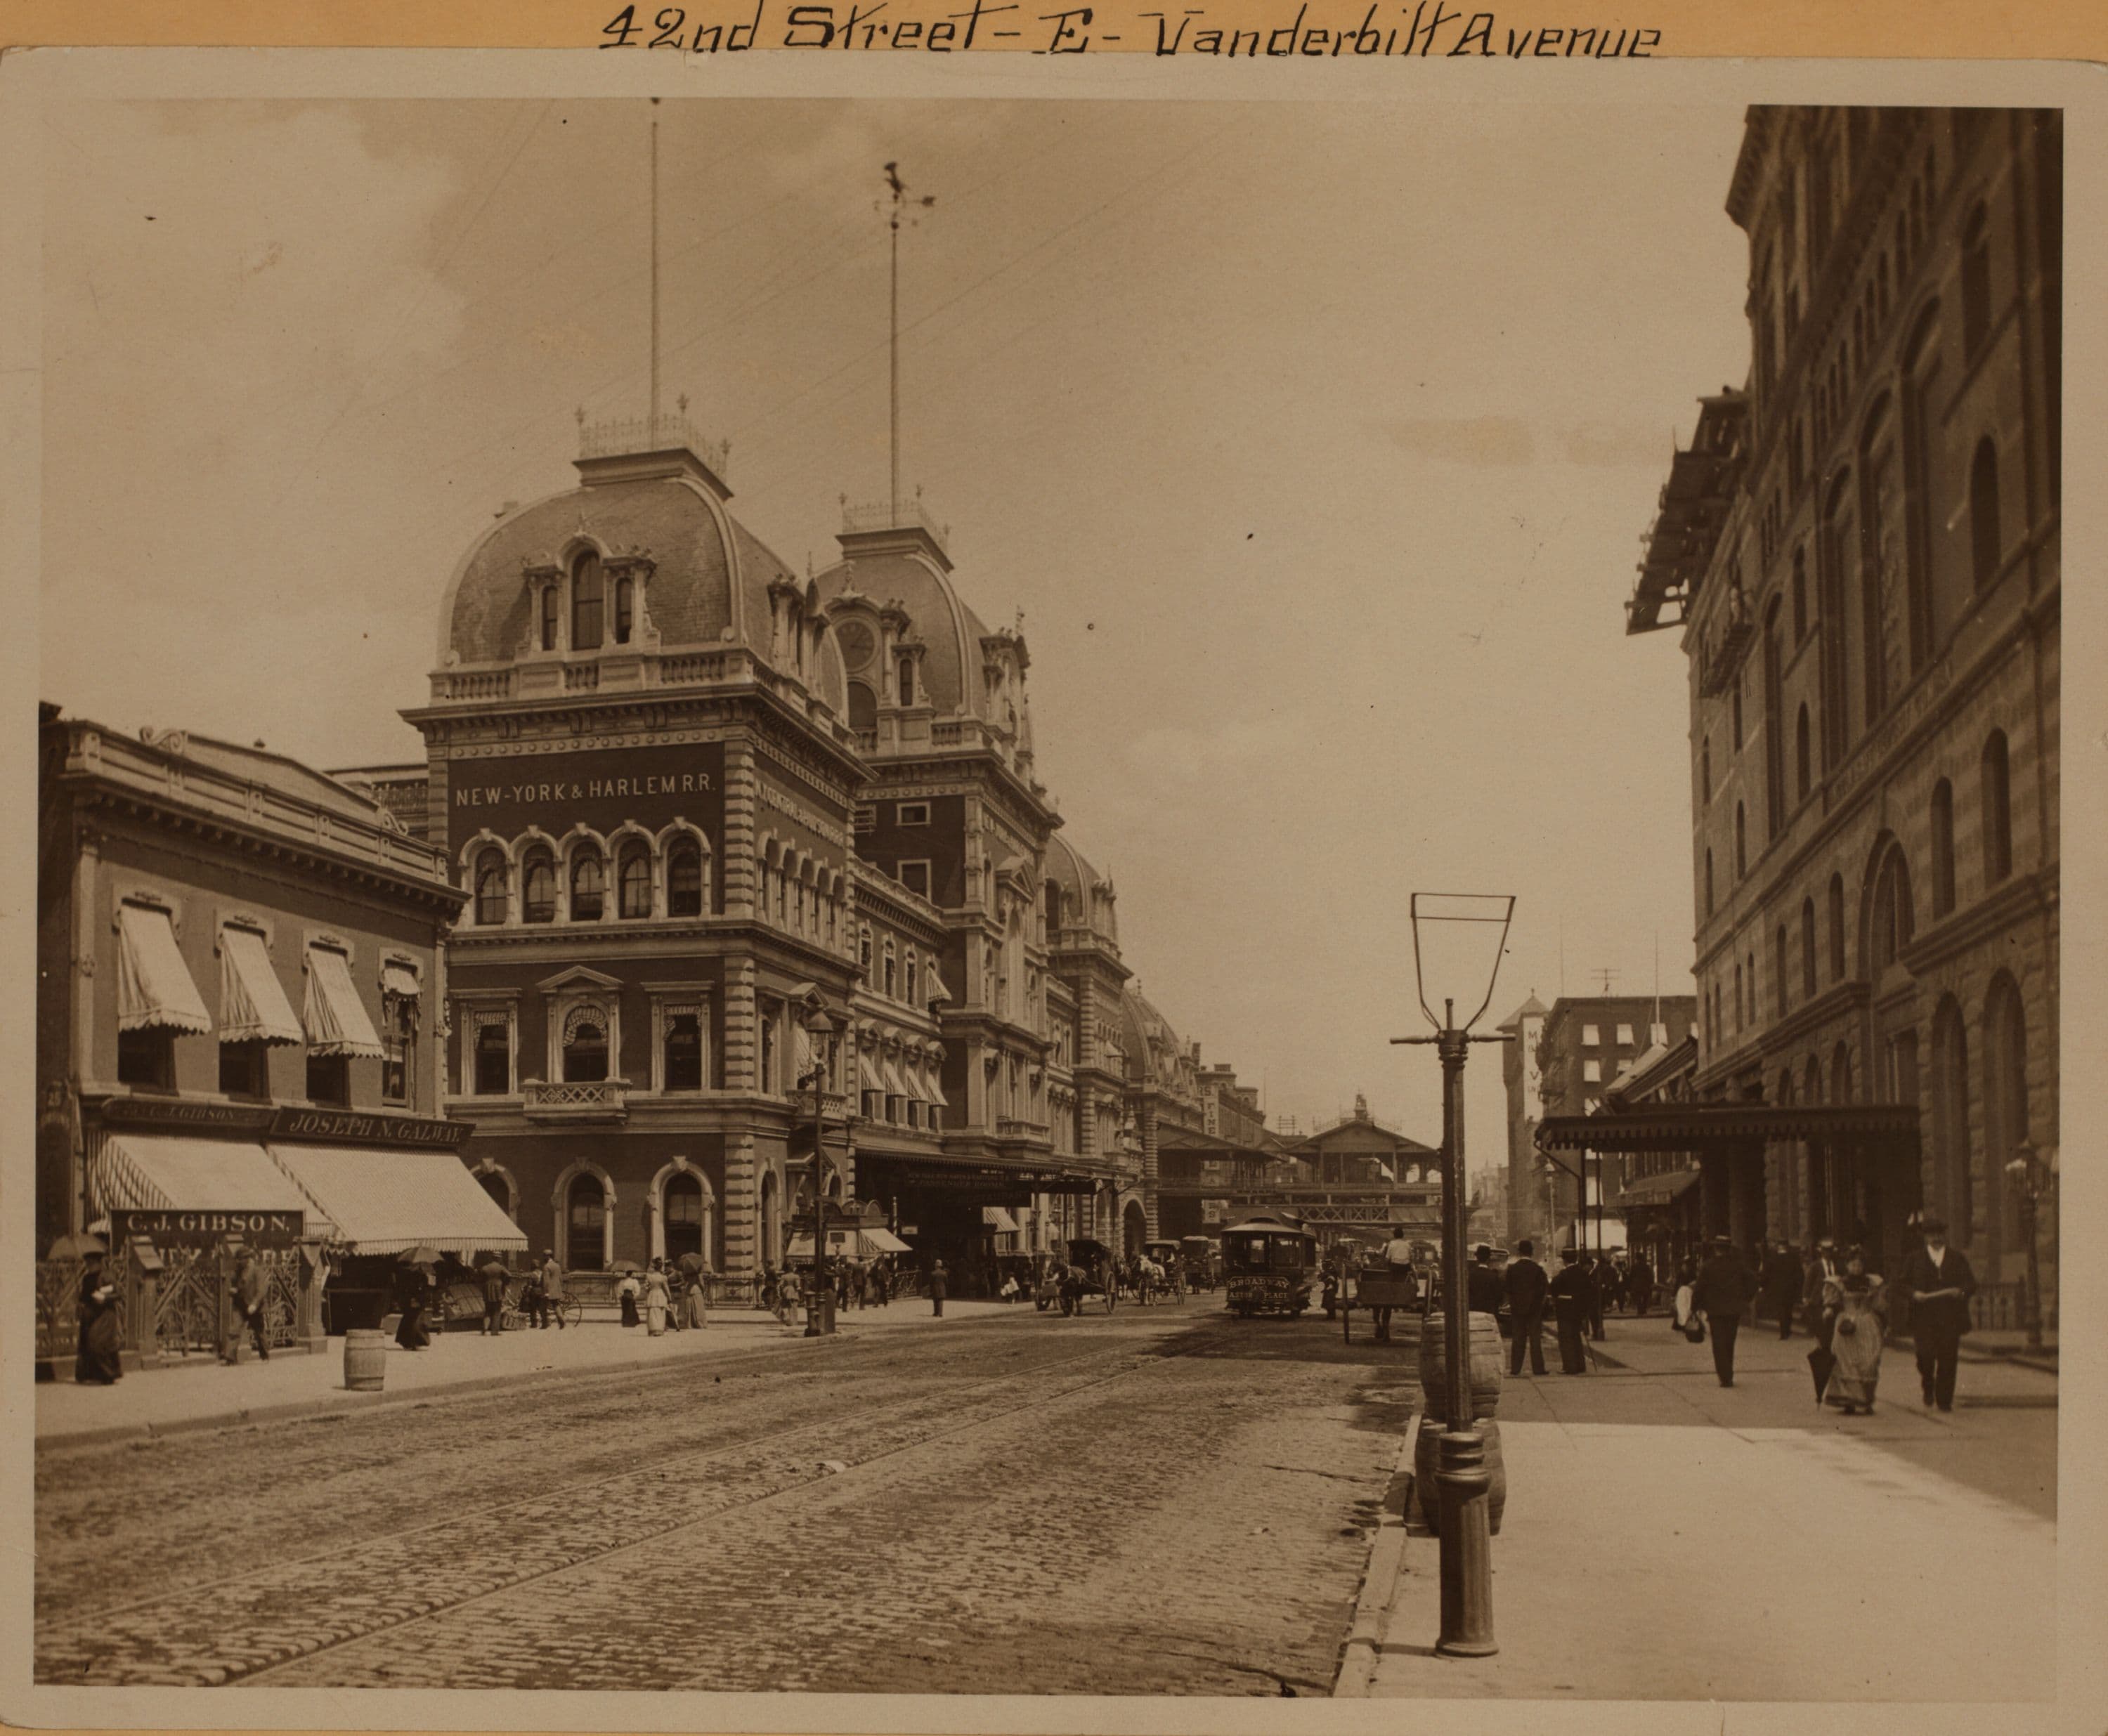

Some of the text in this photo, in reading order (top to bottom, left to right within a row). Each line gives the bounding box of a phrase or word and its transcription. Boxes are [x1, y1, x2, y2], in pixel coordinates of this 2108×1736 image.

[599, 0, 762, 53] 42nd
[786, 0, 1020, 50] Street
[1138, 0, 1462, 58] Vanderbilt
[1446, 12, 1662, 59] Avenue
[456, 783, 566, 807] NEW-YORK
[571, 785, 583, 799] &
[589, 776, 675, 798] HARLEM
[289, 1114, 374, 1136] JOSEPH
[127, 1214, 148, 1231] C.
[154, 1214, 171, 1231] J.
[1230, 1279, 1289, 1288] BROADWAY
